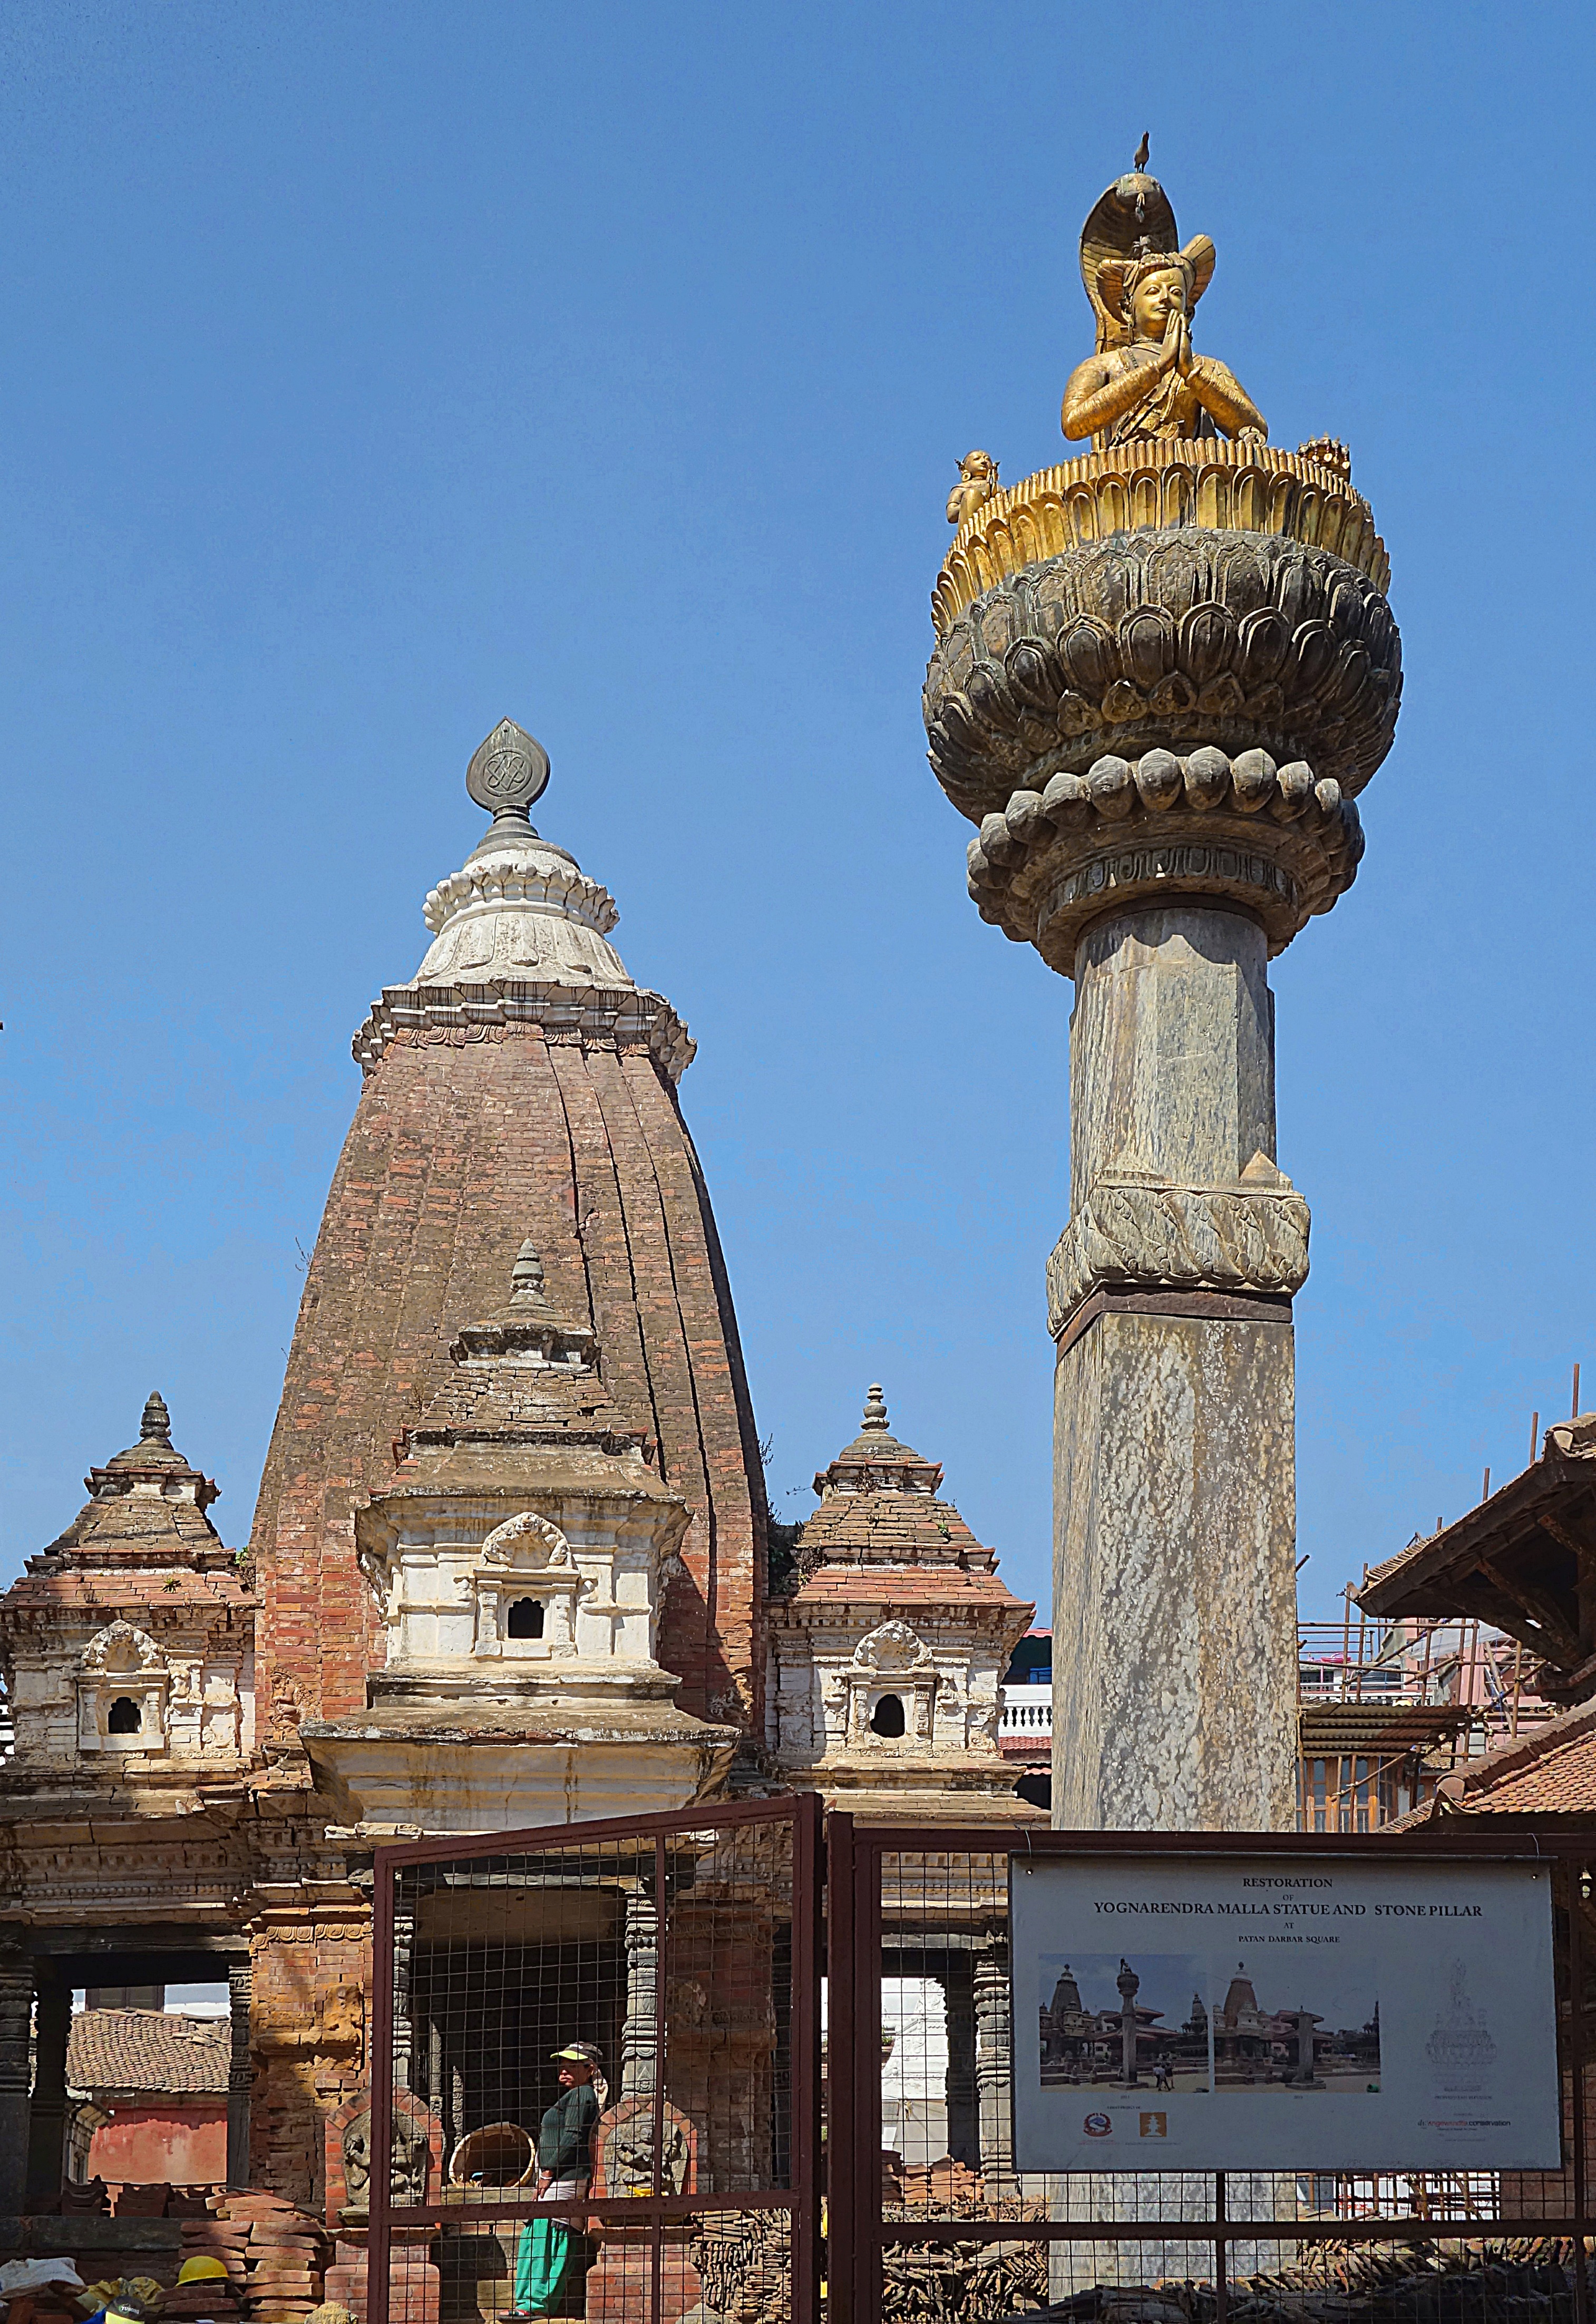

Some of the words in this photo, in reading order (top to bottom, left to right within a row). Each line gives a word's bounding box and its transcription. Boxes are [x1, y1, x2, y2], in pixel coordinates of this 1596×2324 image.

[1243, 1878, 1332, 1887] RESTORATION
[1094, 1902, 1214, 1914] YOGNARENDRA
[1217, 1903, 1271, 1914] MALLA
[1273, 1904, 1330, 1915] STATUE
[1332, 1904, 1366, 1915] AND
[1375, 1905, 1426, 1916] STONE
[1429, 1905, 1483, 1916] PILLAR
[1306, 1936, 1340, 1944] SQUARE
